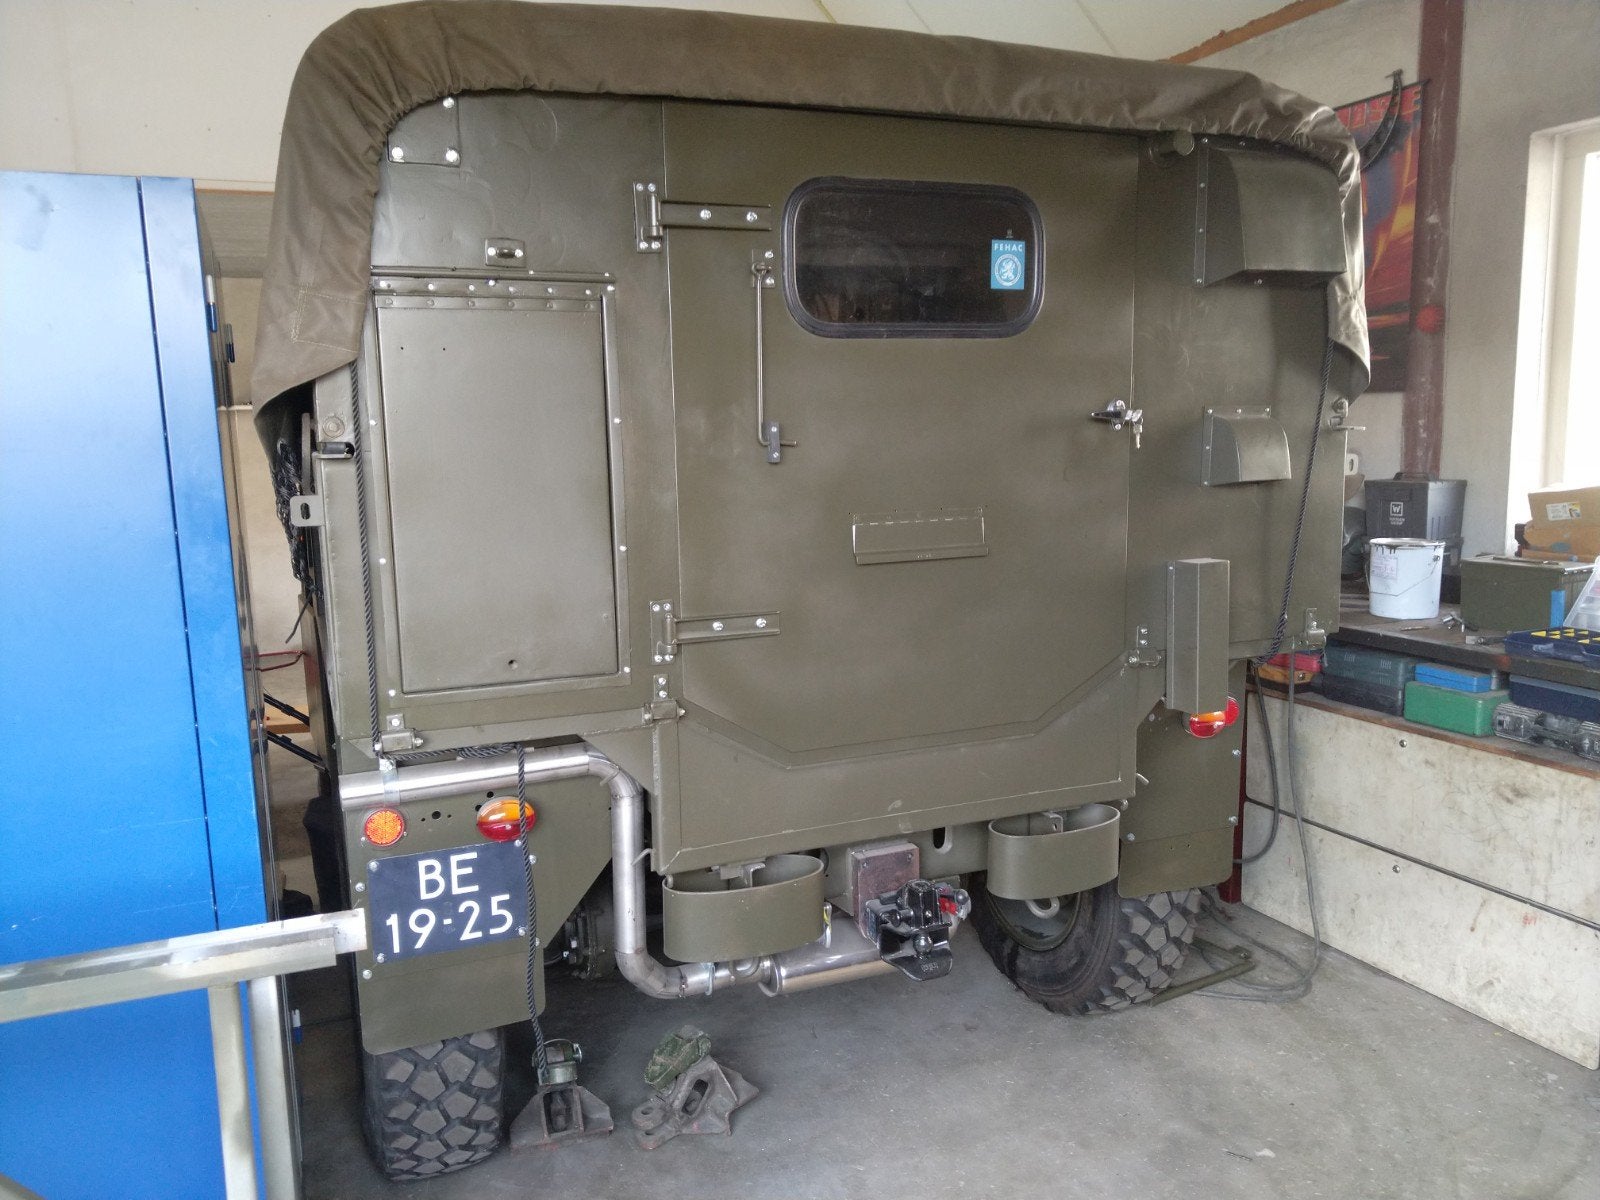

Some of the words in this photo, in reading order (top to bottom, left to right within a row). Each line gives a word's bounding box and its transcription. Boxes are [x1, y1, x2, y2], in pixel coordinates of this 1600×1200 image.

[994, 243, 1023, 251] FEHAC
[418, 852, 479, 900] BE
[386, 894, 513, 954] 19-25
